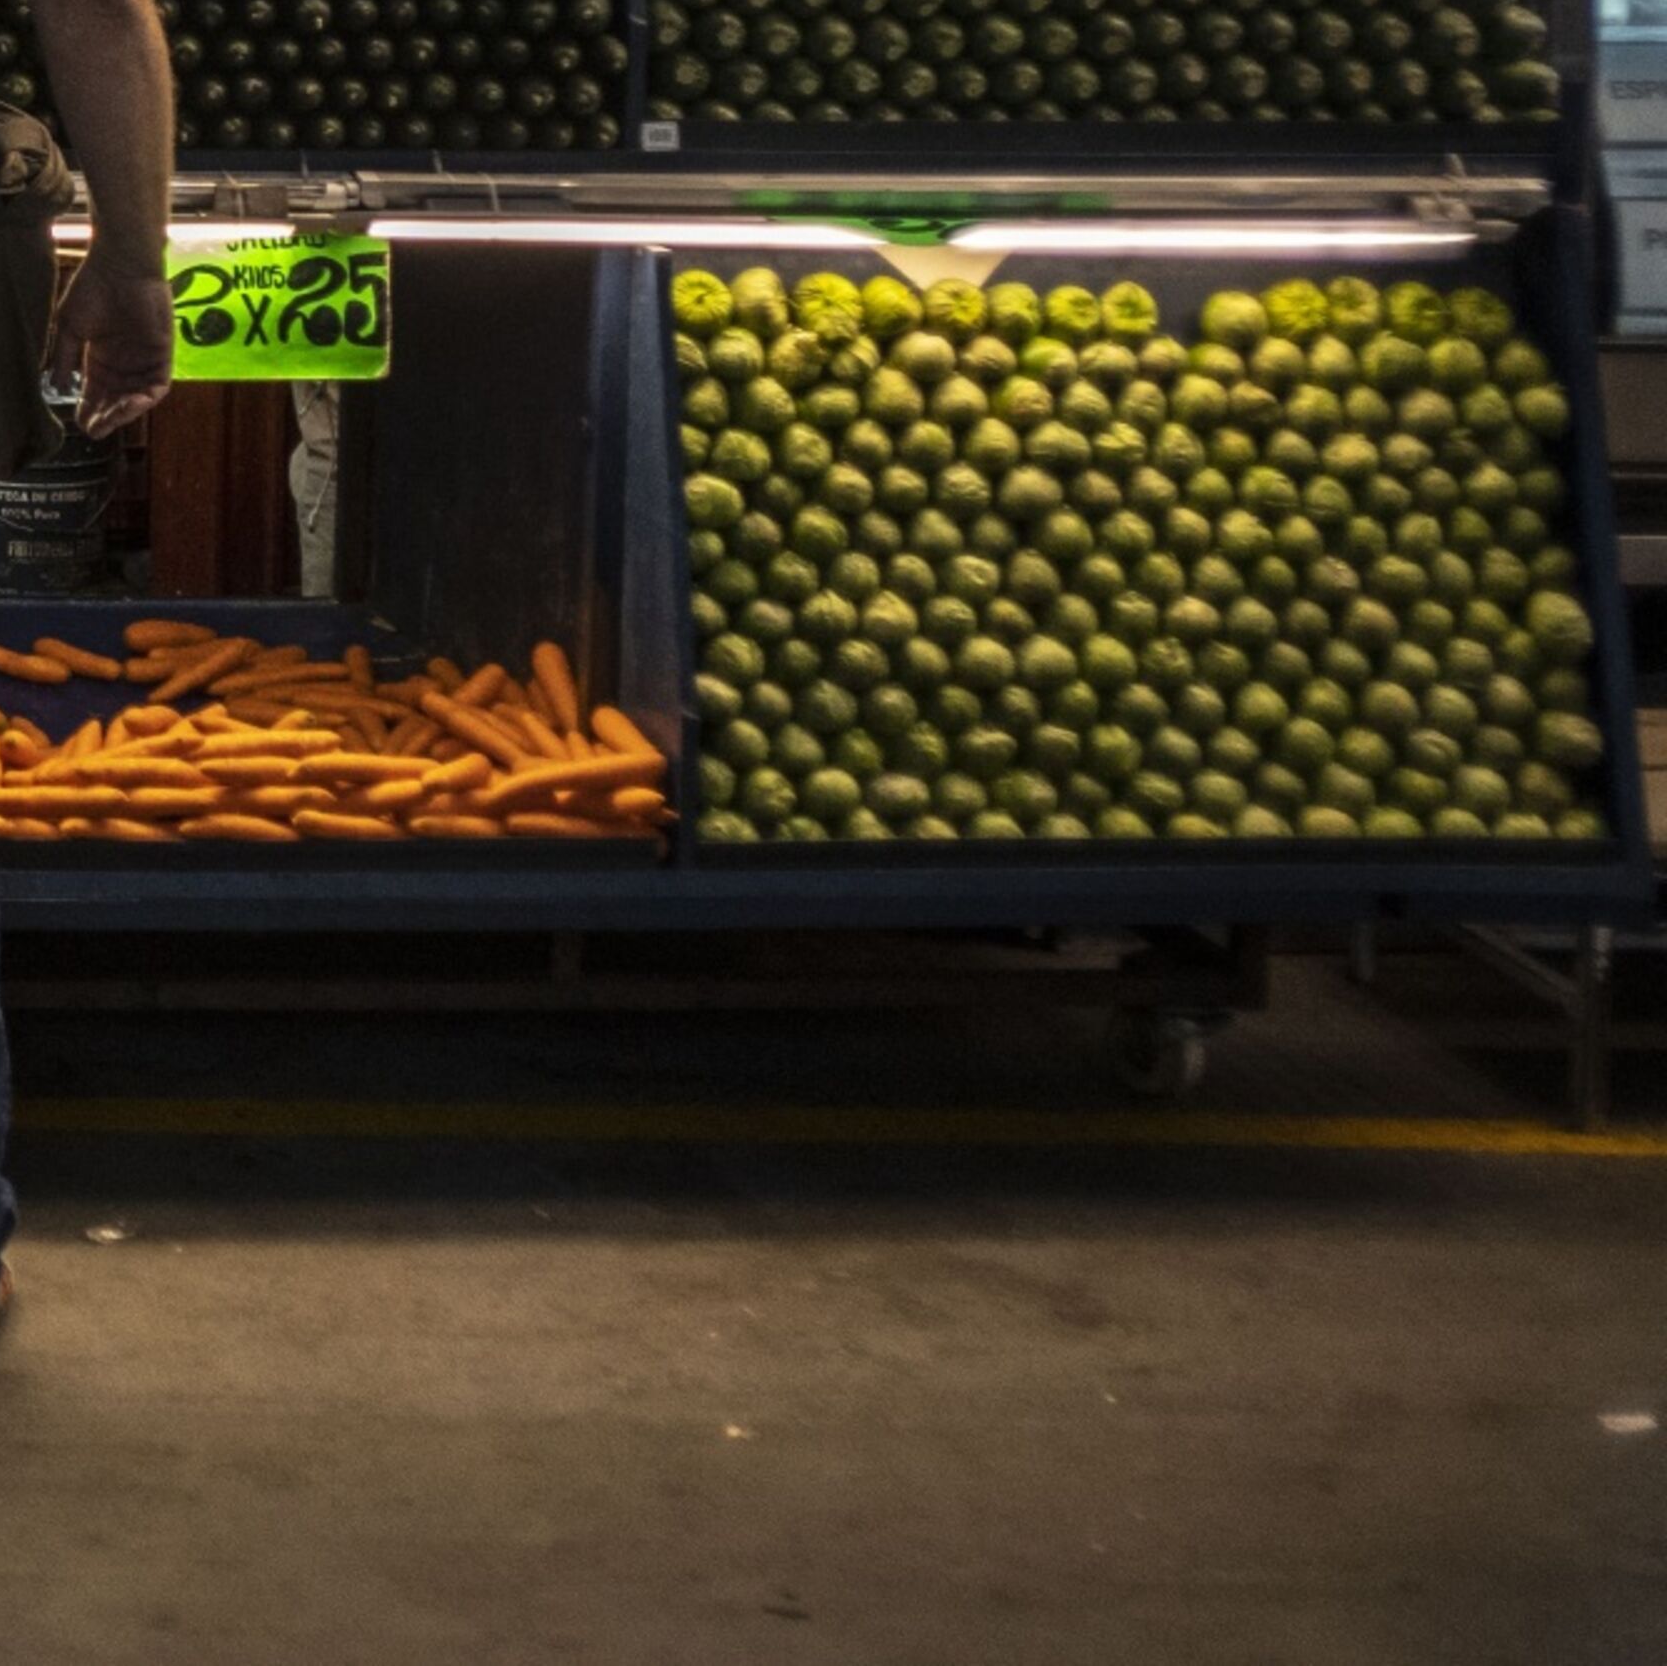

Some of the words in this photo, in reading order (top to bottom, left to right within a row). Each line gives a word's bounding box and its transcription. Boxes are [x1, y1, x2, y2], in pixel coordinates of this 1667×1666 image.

[169, 263, 236, 347] 2
[241, 293, 272, 347] X
[277, 251, 389, 347] 25
[233, 265, 286, 289] KILOS
